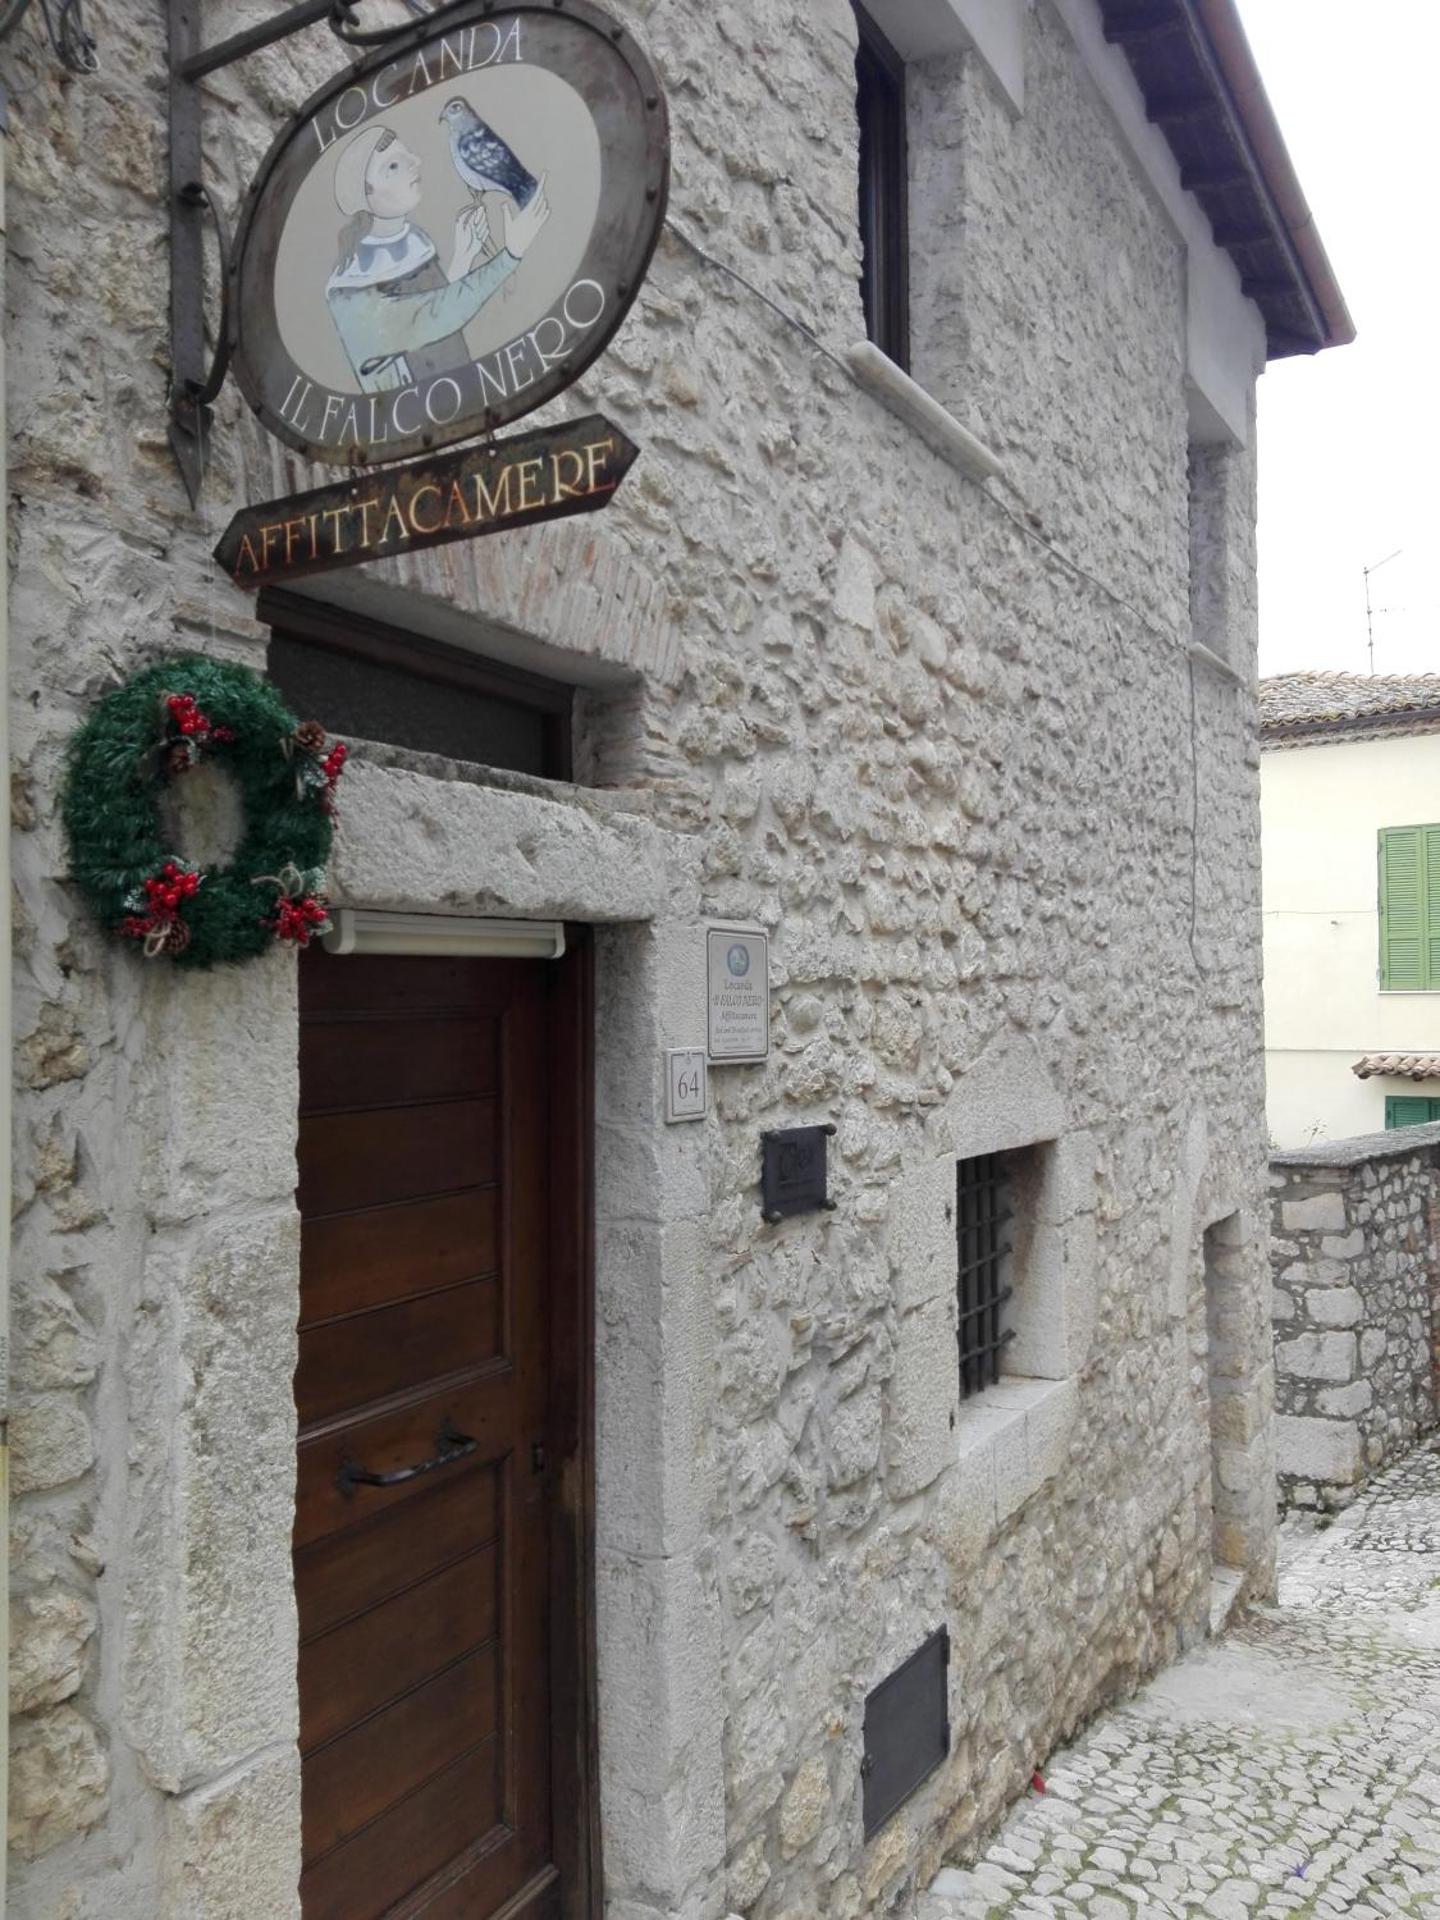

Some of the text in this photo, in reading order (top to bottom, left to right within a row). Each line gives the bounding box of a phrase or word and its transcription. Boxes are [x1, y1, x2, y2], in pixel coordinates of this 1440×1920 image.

[311, 17, 523, 153] LOCANDA
[279, 279, 605, 446] IL FALCO NERO
[235, 438, 616, 578] AFFITTACAMERE
[678, 1071, 699, 1099] 64
